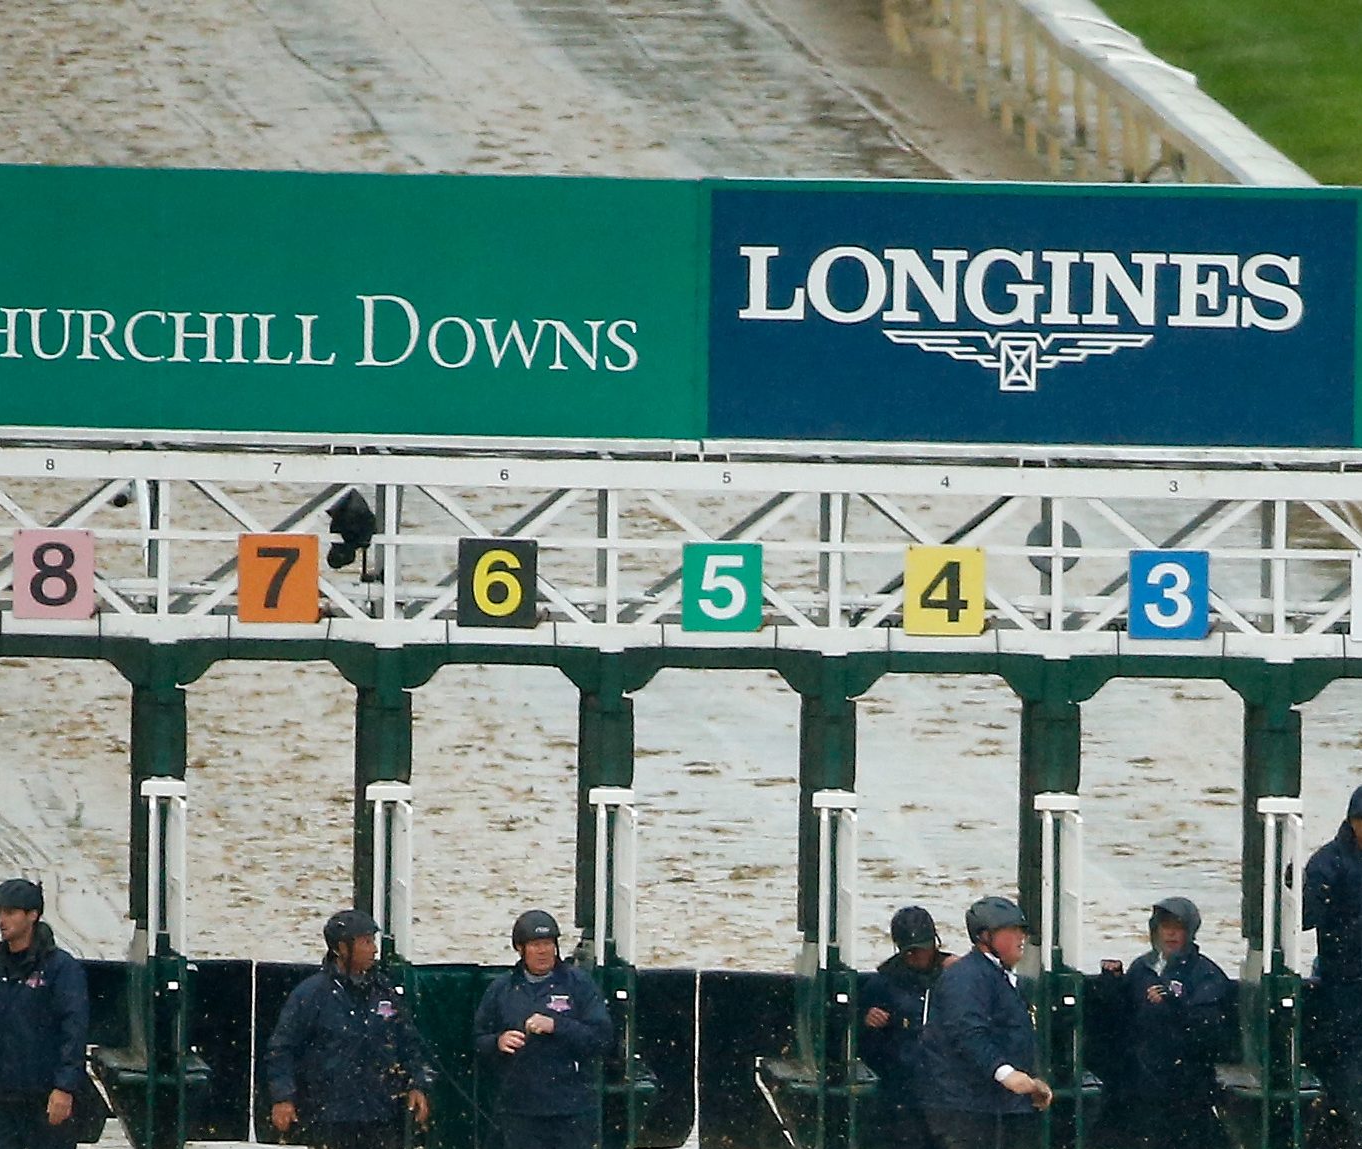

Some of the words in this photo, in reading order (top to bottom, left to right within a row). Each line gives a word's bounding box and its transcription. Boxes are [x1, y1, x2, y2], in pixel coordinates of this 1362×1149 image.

[738, 246, 1304, 331] LONGINES
[355, 296, 637, 371] DOWNS
[46, 459, 54, 470] 8
[273, 462, 281, 474] 7
[500, 469, 509, 480] 6
[723, 472, 731, 483] 5
[941, 476, 949, 487] 4
[1169, 481, 1178, 492] 3
[29, 541, 78, 608] 8
[256, 546, 301, 609] 7
[471, 549, 523, 618] 6
[697, 554, 747, 621] 5
[919, 560, 969, 623] 4
[1144, 562, 1193, 629] 3
